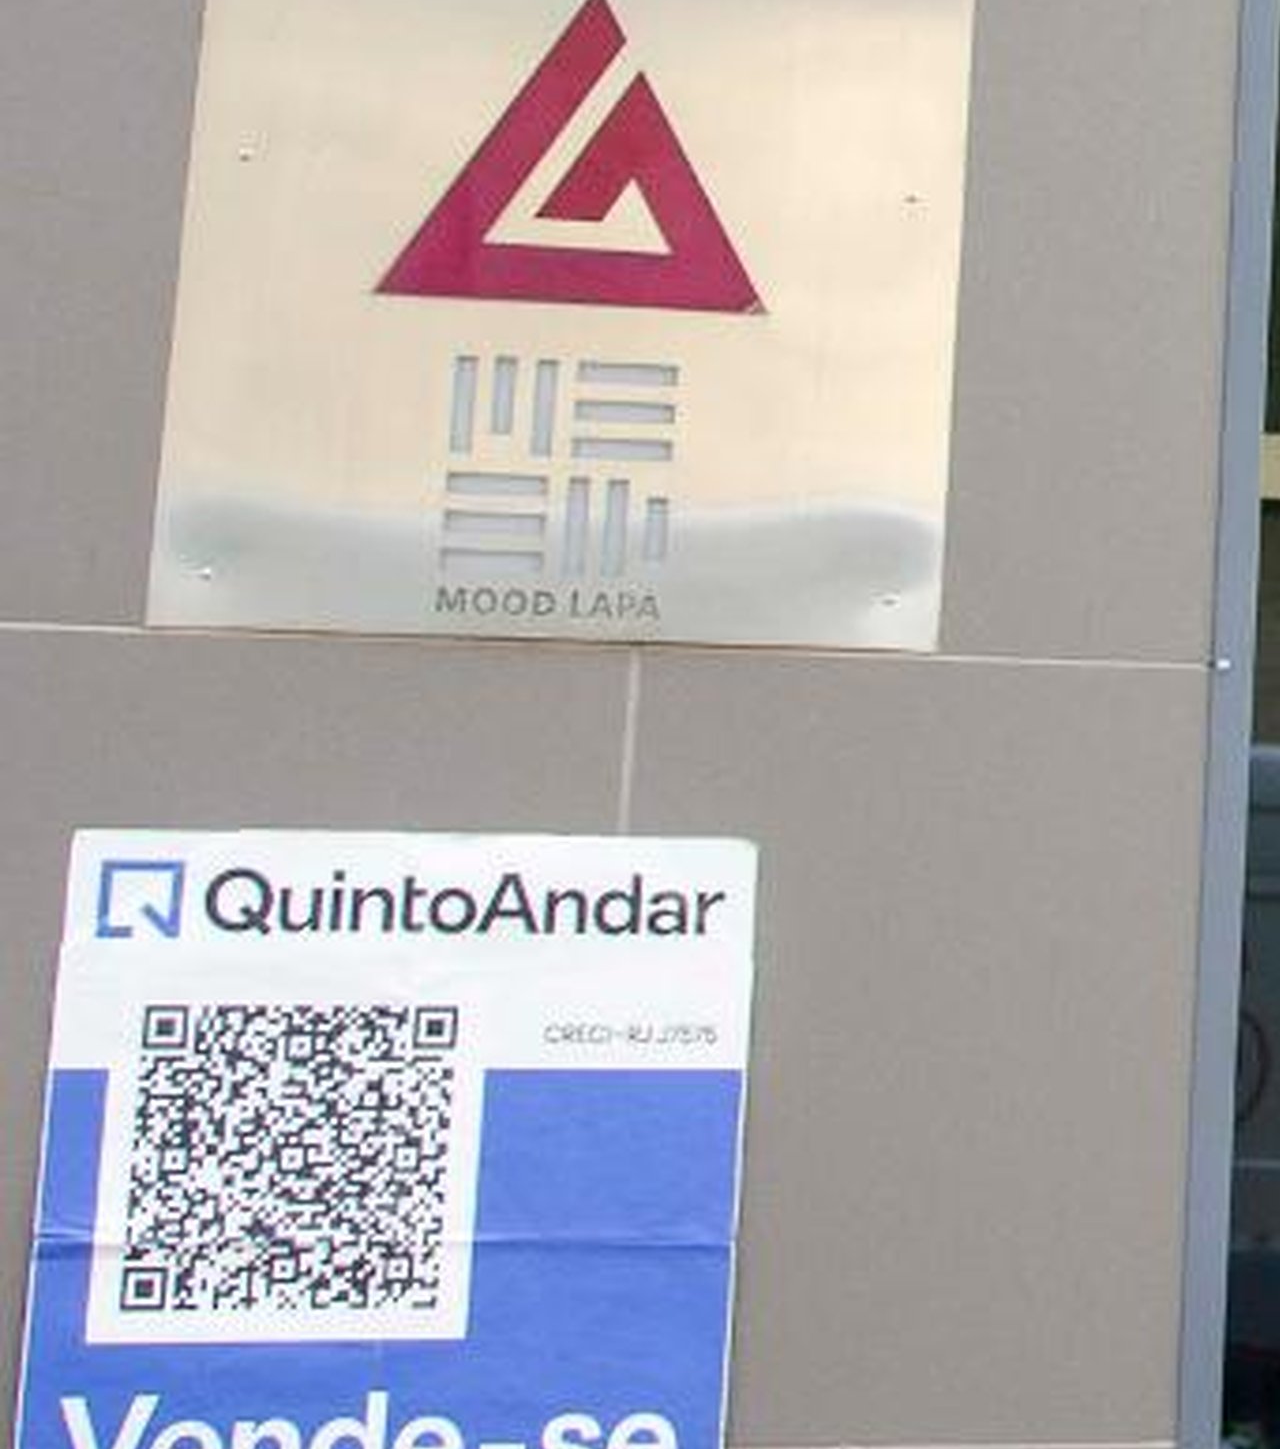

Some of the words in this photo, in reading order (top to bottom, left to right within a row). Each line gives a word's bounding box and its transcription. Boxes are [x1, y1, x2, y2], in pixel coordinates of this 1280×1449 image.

[434, 586, 557, 617] MOOD
[570, 588, 661, 620] LAPA
[204, 868, 726, 940] QuintoAndar
